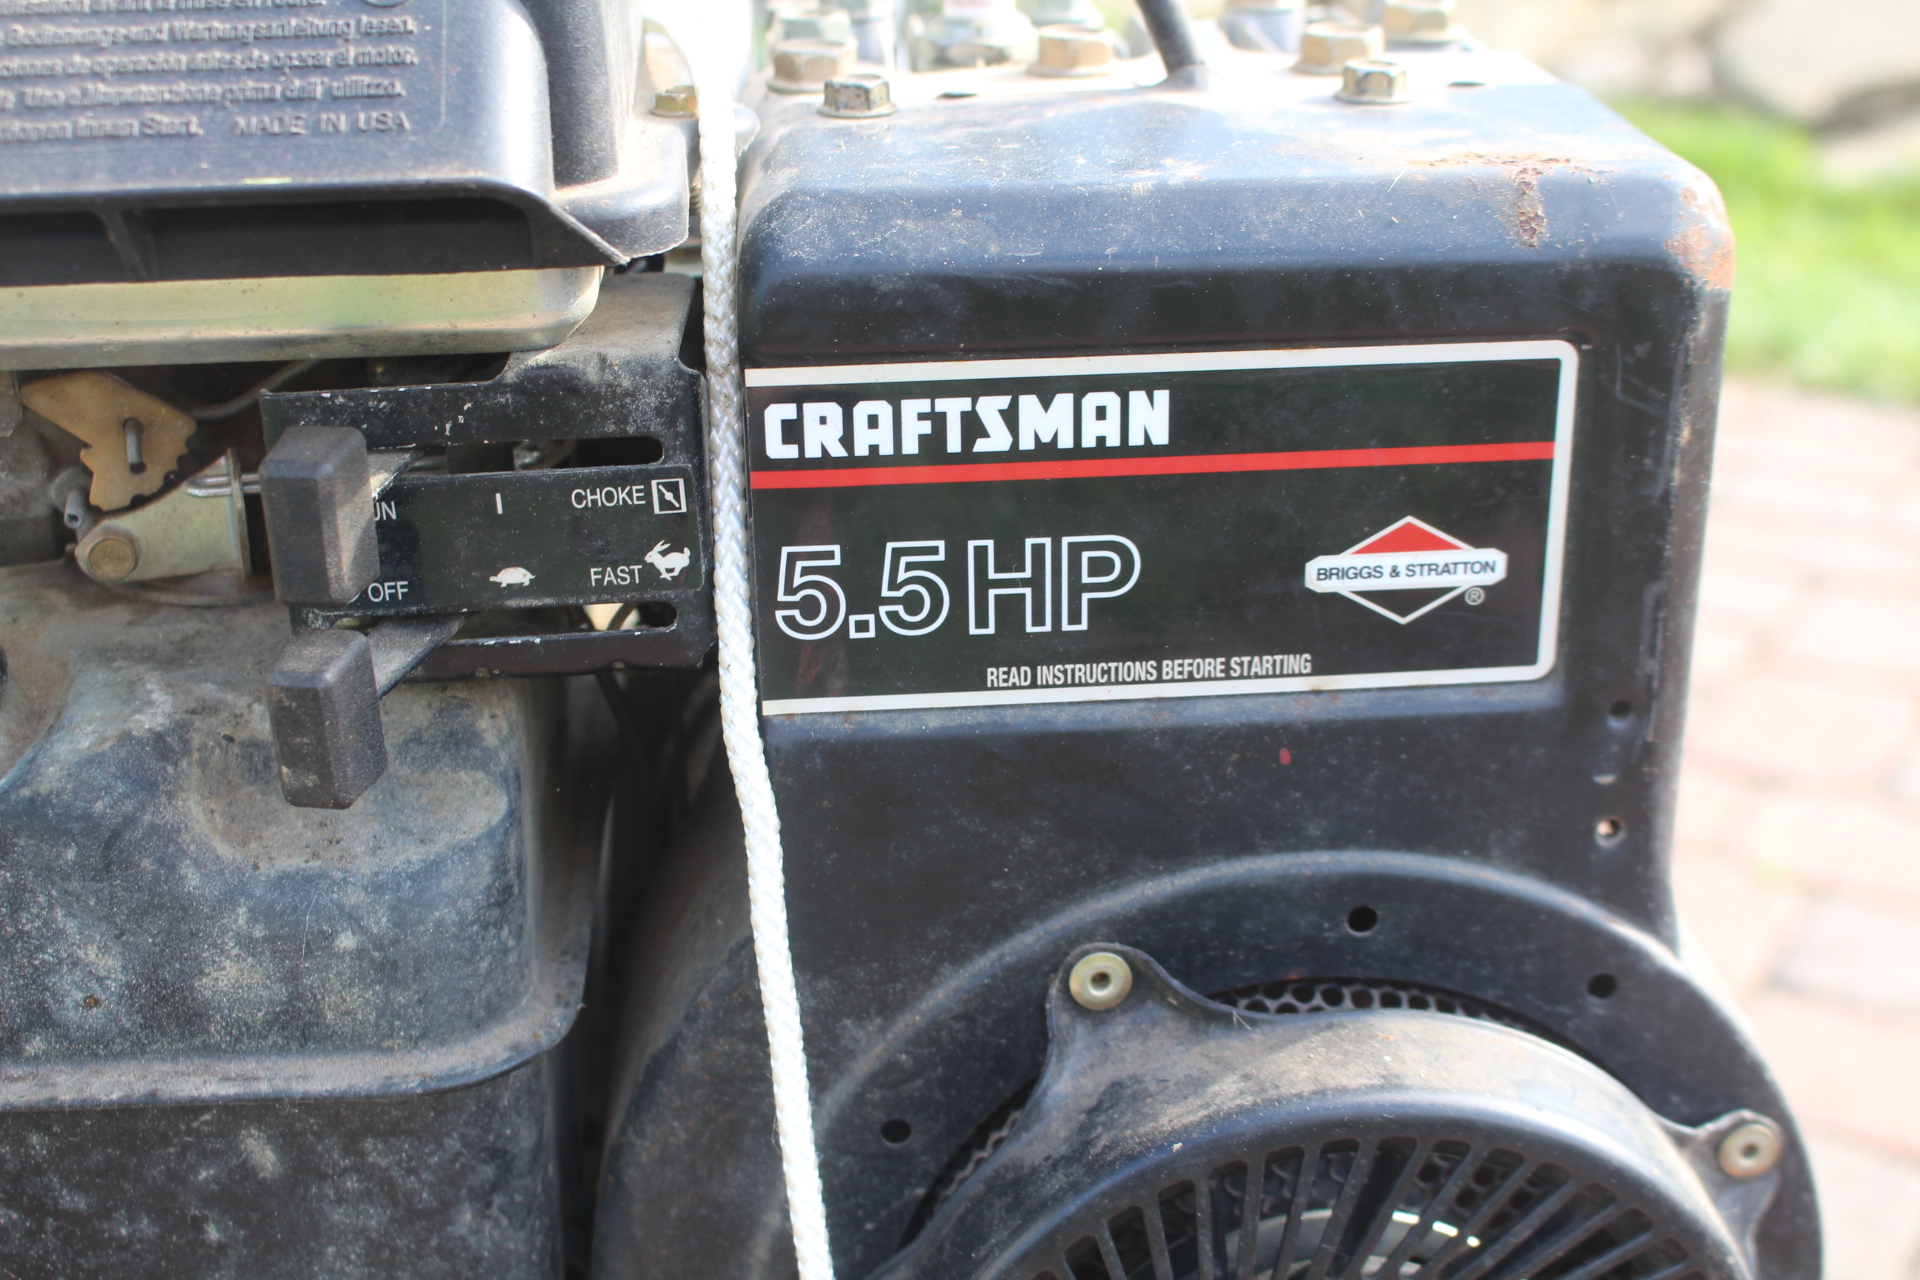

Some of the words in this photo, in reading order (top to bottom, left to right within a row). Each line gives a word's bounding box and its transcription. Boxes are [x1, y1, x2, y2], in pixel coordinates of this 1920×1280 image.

[234, 112, 307, 136] MADE
[319, 111, 347, 133] IN
[356, 109, 412, 132] USA
[764, 389, 1170, 460] CRAFTSMAN
[571, 485, 646, 509] CHOKE
[590, 565, 643, 587] FAST
[1316, 566, 1384, 581] BRIGGS
[1389, 565, 1401, 578] &
[1405, 560, 1496, 577] STRATTON
[368, 581, 409, 603] OFF
[987, 666, 1031, 687] READ
[1037, 660, 1157, 685] INSTRUCTIONS
[1161, 656, 1226, 680] BEFORE
[1229, 653, 1312, 677] STARTING
